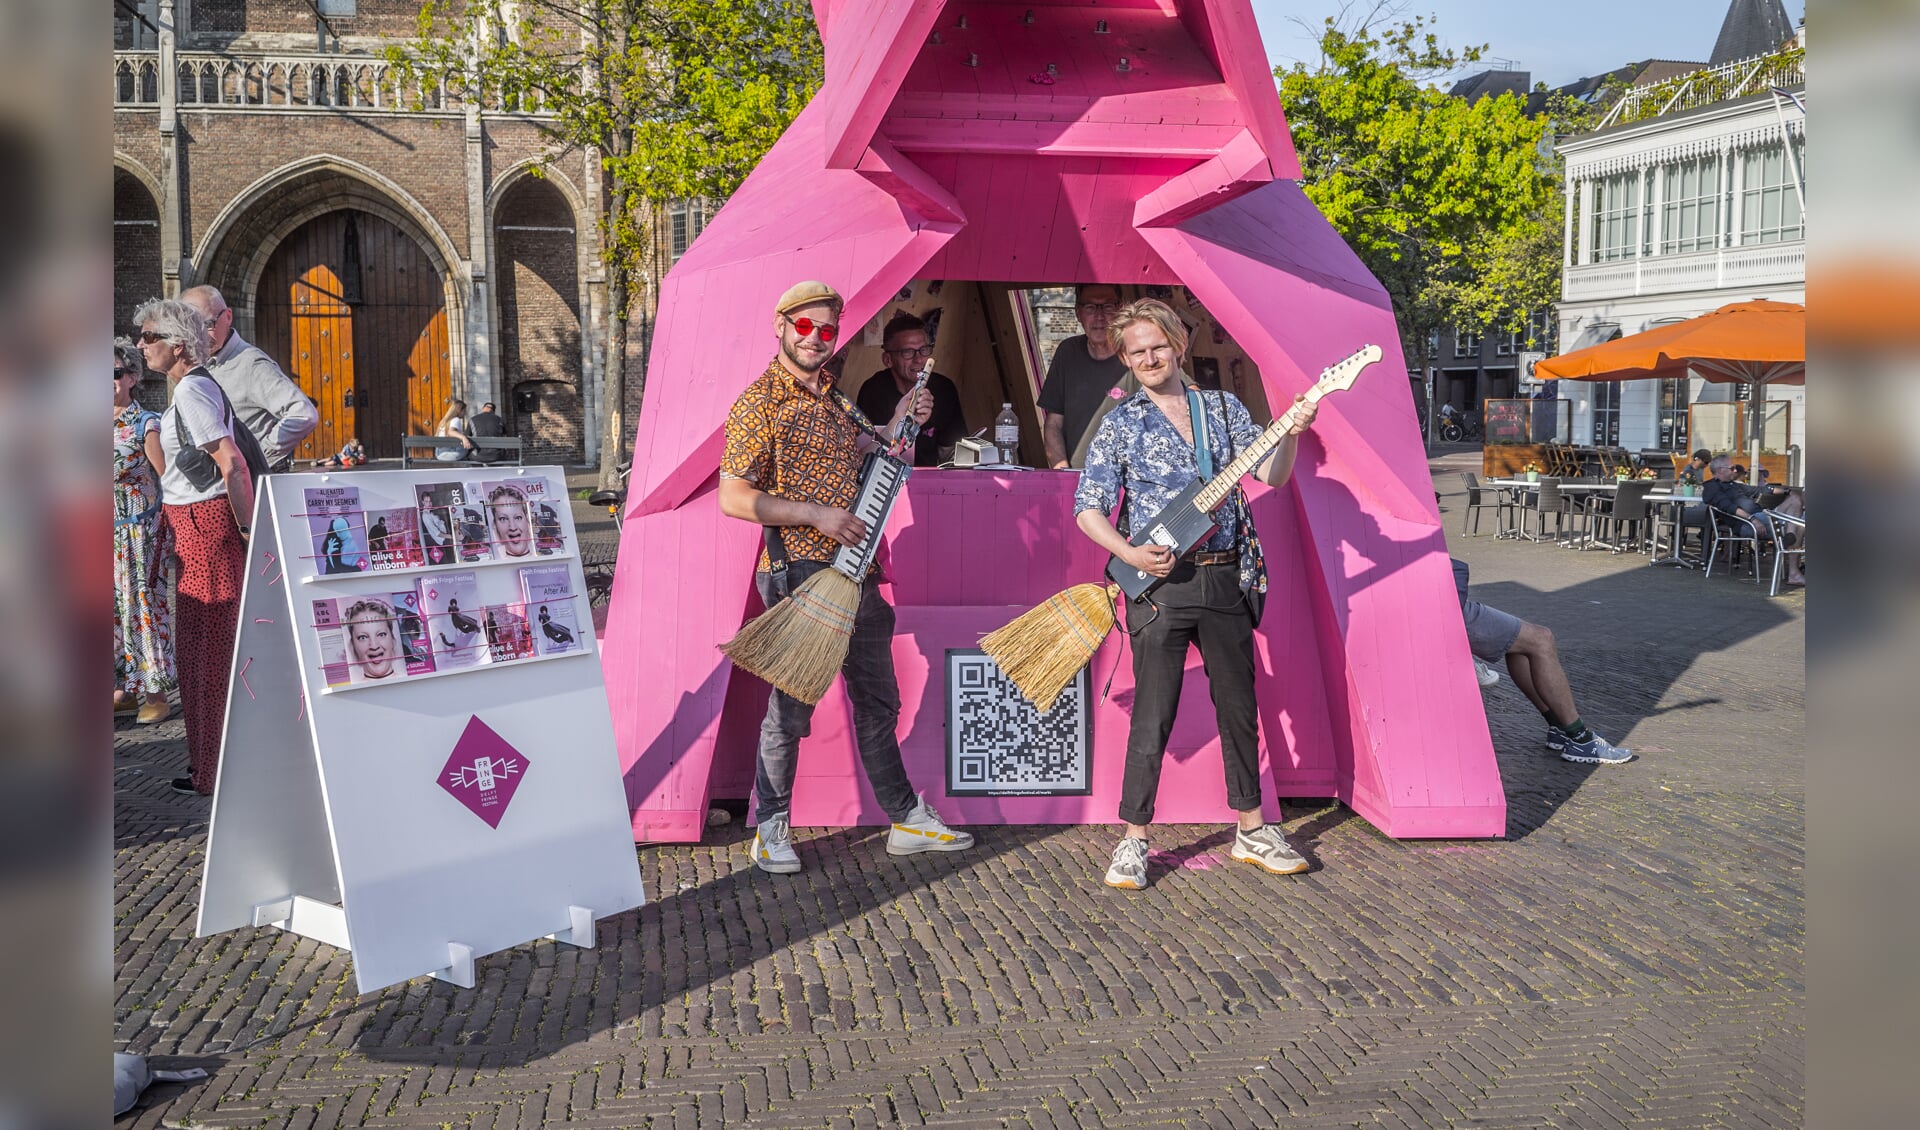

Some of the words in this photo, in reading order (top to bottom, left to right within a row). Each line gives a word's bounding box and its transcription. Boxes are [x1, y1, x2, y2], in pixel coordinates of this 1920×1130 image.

[320, 488, 344, 496] ALIENATED
[526, 482, 544, 493] CAFÉ
[308, 499, 325, 507] CARRY
[326, 499, 333, 507] MY
[334, 498, 358, 506] SEGMENT
[371, 551, 394, 561] alive
[396, 550, 403, 559] &
[373, 560, 406, 570] unborn
[424, 577, 438, 585] Delft
[438, 576, 454, 584] Fringe
[454, 574, 474, 582] Festival
[544, 587, 558, 595] After
[560, 585, 568, 594] All
[506, 642, 513, 651] &
